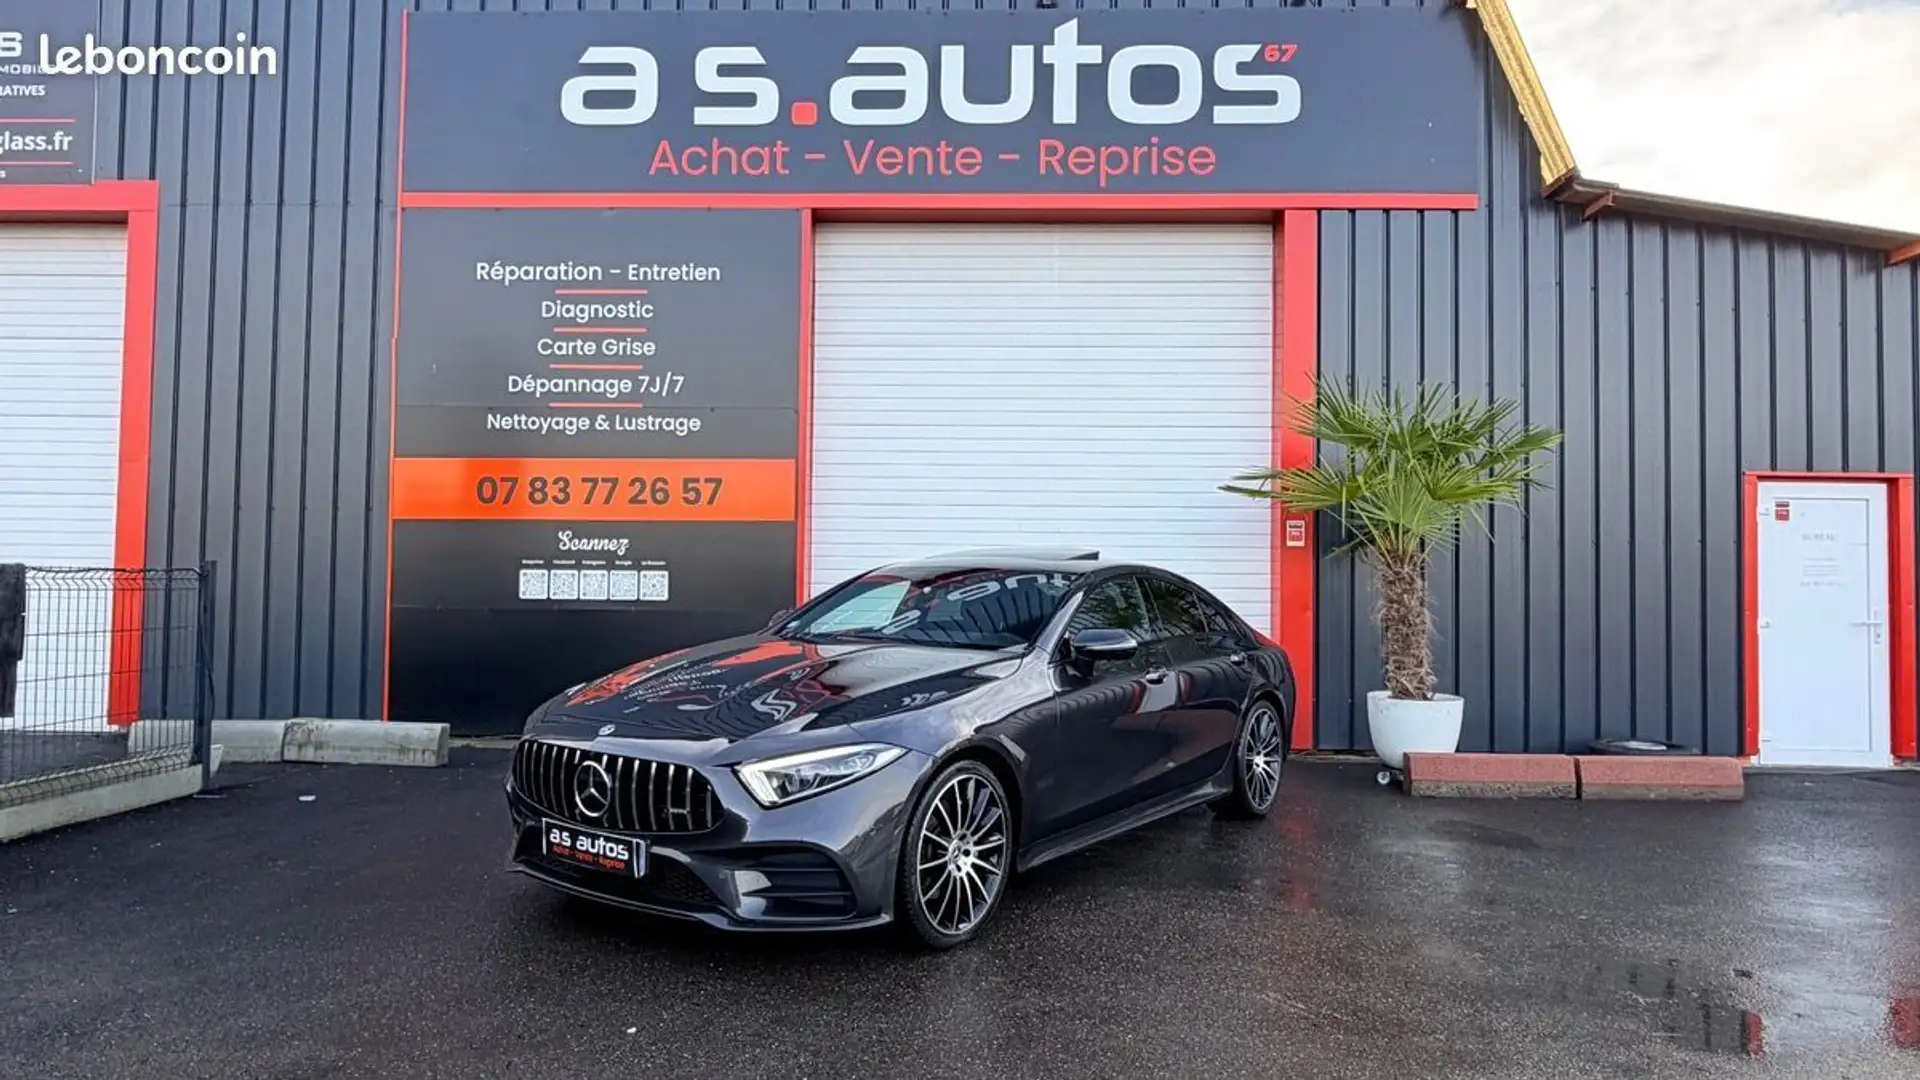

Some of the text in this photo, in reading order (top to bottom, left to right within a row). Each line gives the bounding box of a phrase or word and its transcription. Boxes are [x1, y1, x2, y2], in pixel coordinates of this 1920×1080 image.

[1264, 43, 1298, 62] 67
[649, 139, 789, 176] Achat
[843, 140, 984, 176] Vente
[1038, 138, 1217, 187] Reprise
[475, 260, 603, 287] Réparation
[627, 262, 721, 282] Entretien
[540, 299, 655, 324] Diagnostic
[536, 337, 657, 357] Carte Grise
[507, 371, 685, 399] Dépannage 7J/7
[486, 413, 702, 437] Nettoyage & Lustrage
[475, 476, 724, 506] 07 83 77 26 57
[557, 529, 631, 557] Scannez
[549, 828, 630, 861] as autos
